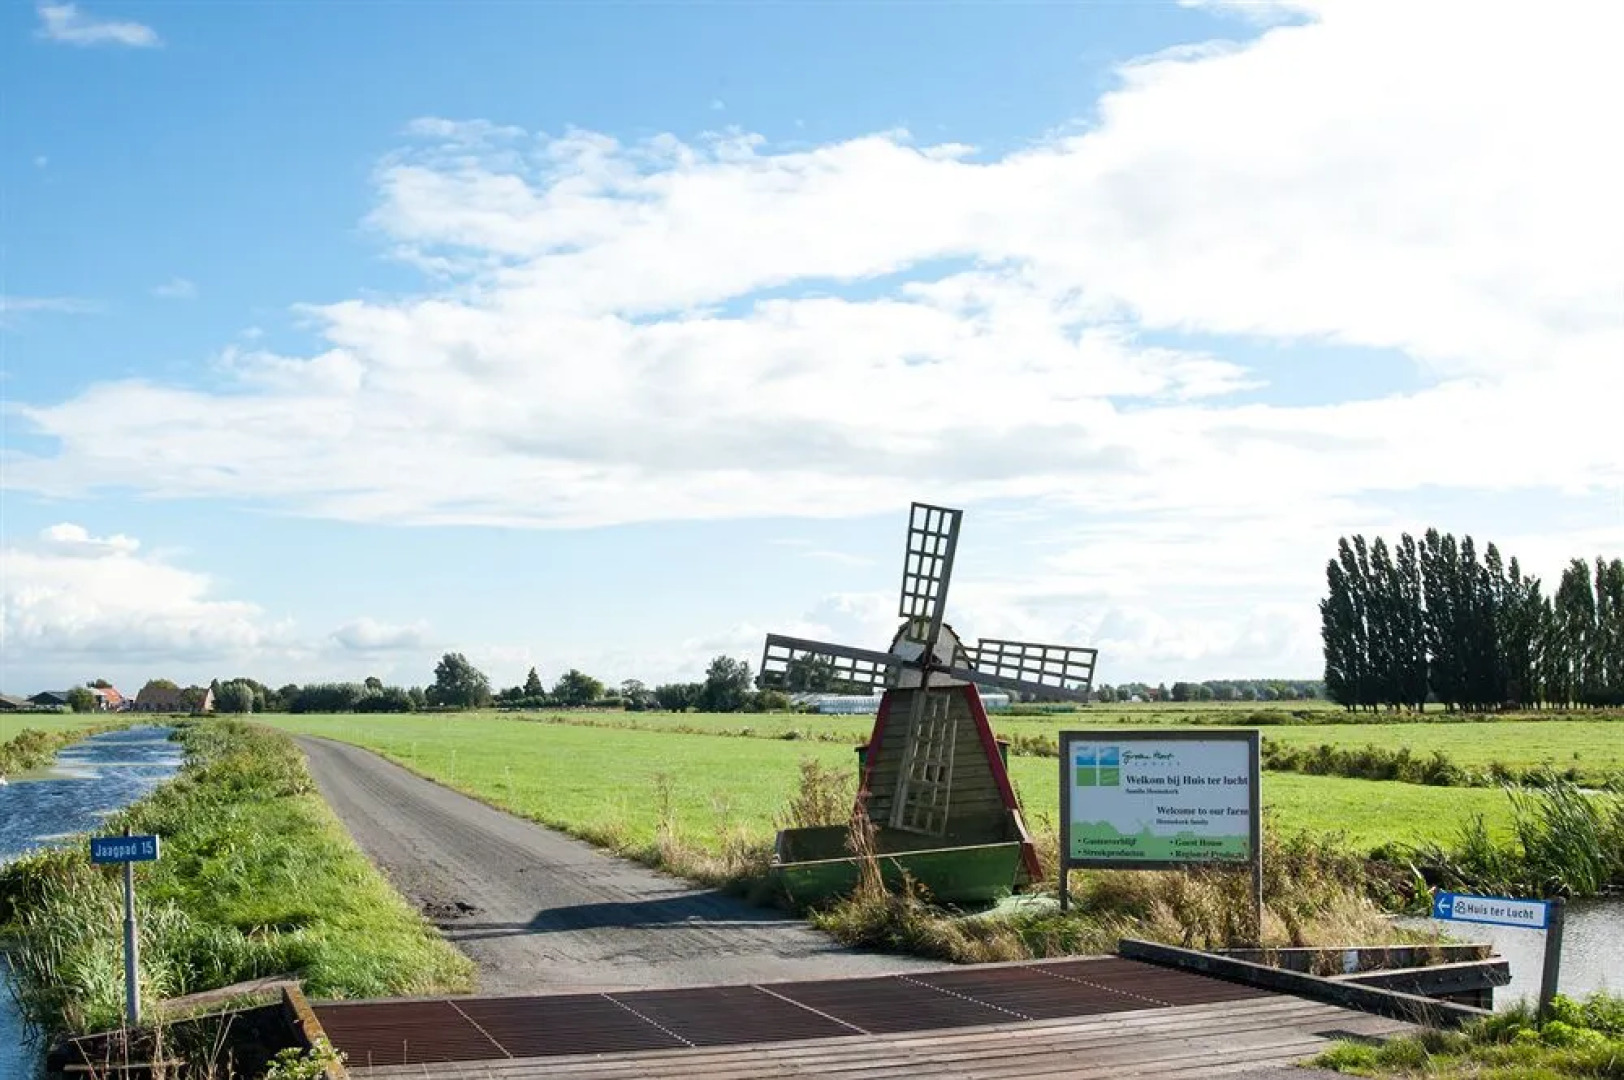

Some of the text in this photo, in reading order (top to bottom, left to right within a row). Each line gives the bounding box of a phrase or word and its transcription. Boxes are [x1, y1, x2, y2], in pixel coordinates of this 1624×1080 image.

[1126, 775, 1248, 786] Welkom bij Huis ter lucht
[1157, 806, 1249, 815] Welcome to our farm
[95, 840, 154, 859] Jaagpad 15
[1467, 904, 1534, 920] Huis ter Lucht
